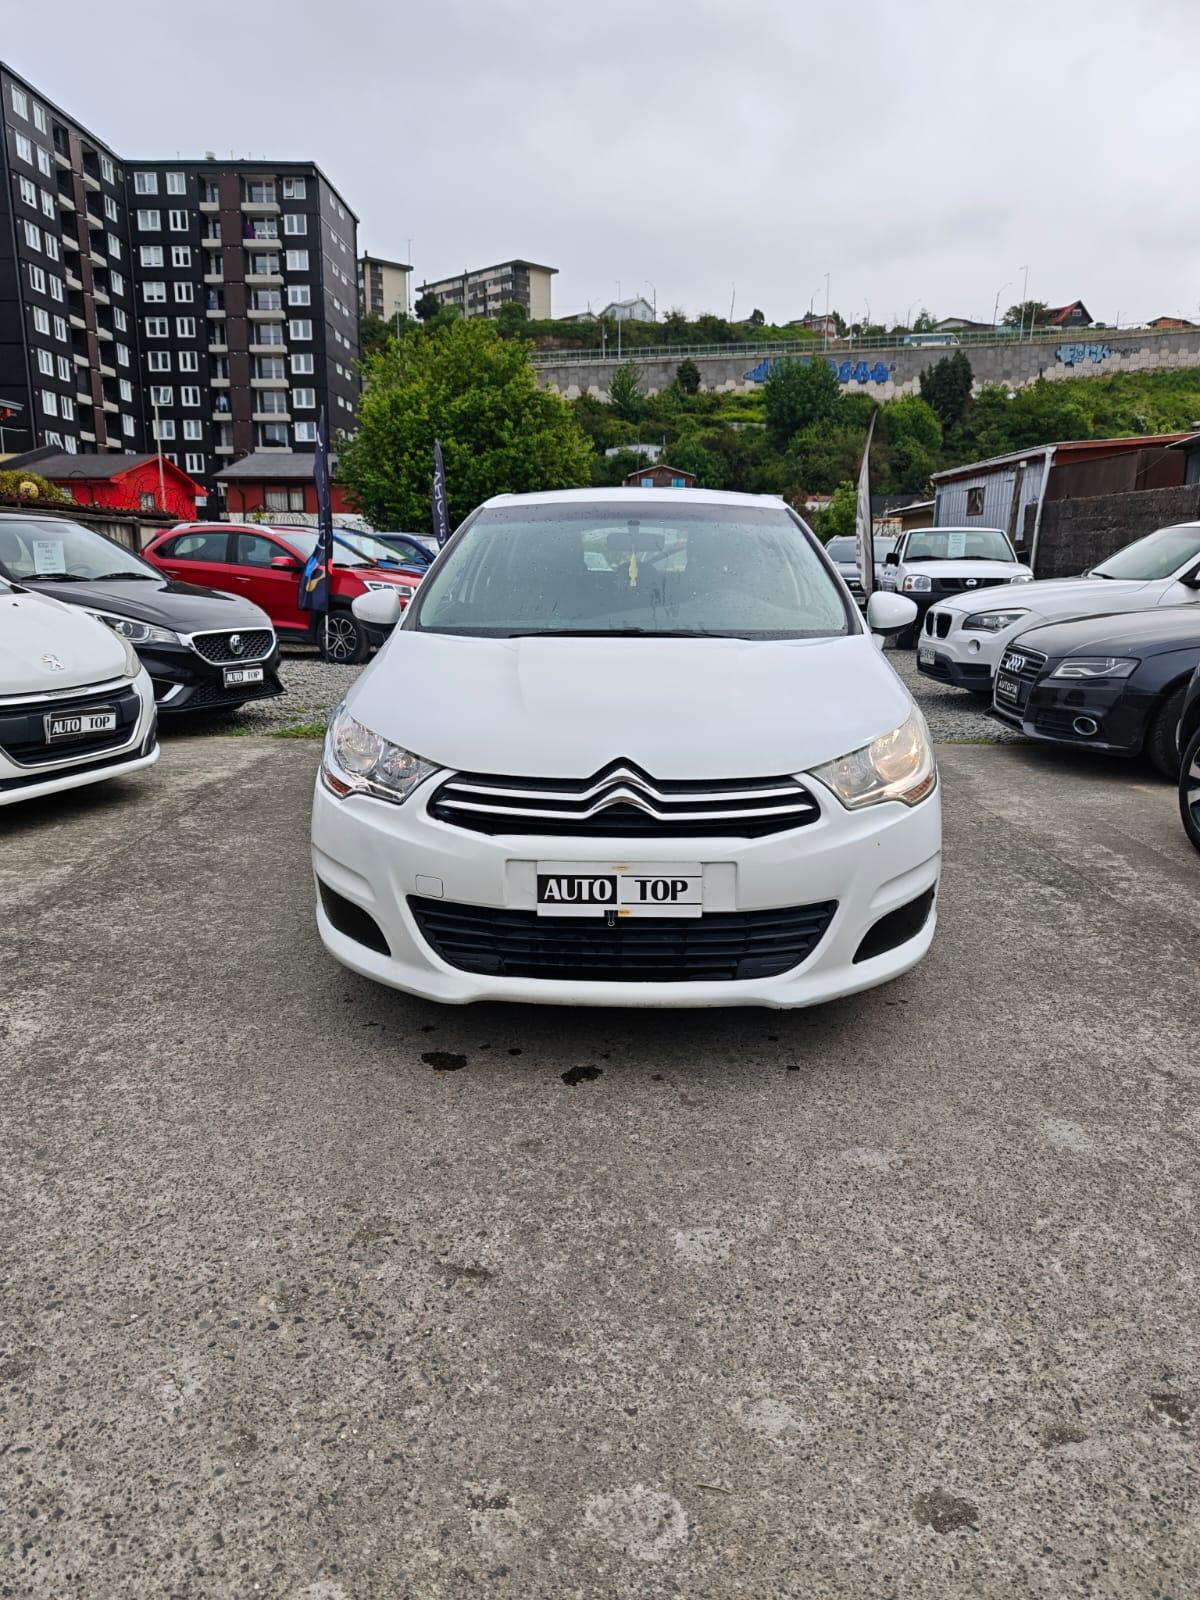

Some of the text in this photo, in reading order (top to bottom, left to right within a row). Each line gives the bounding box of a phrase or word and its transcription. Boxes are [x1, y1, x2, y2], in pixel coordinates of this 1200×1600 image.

[226, 672, 243, 682] AUTO
[52, 716, 110, 735] AUTO TOP
[543, 878, 689, 901] AUTO TOP
